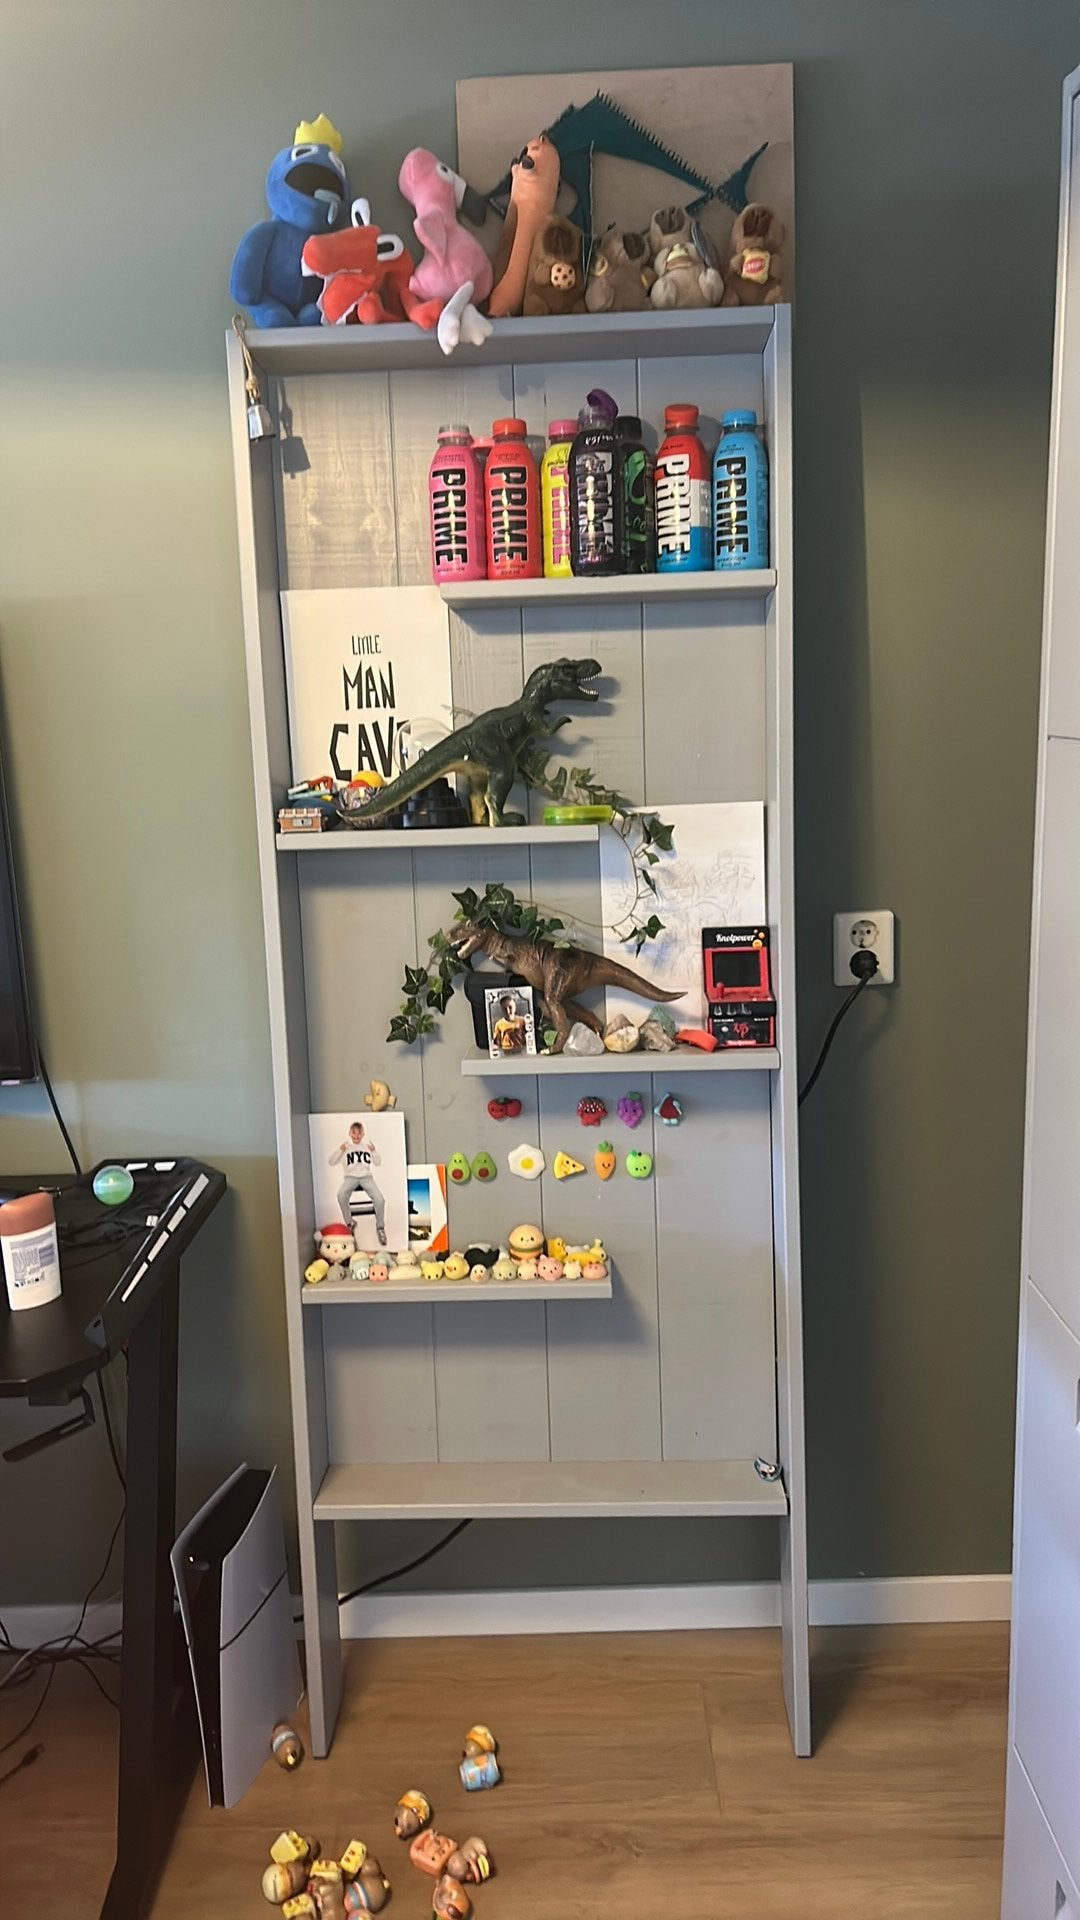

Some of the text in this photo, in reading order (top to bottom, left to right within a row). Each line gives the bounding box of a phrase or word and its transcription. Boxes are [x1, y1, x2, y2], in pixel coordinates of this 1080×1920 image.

[432, 468, 468, 565] PRIME
[490, 466, 527, 564] PRIME
[656, 453, 691, 555] PRIME
[715, 456, 749, 556] PRIME
[342, 660, 396, 711] MAN
[351, 635, 382, 656] LITTLE
[346, 1150, 371, 1166] NYC
